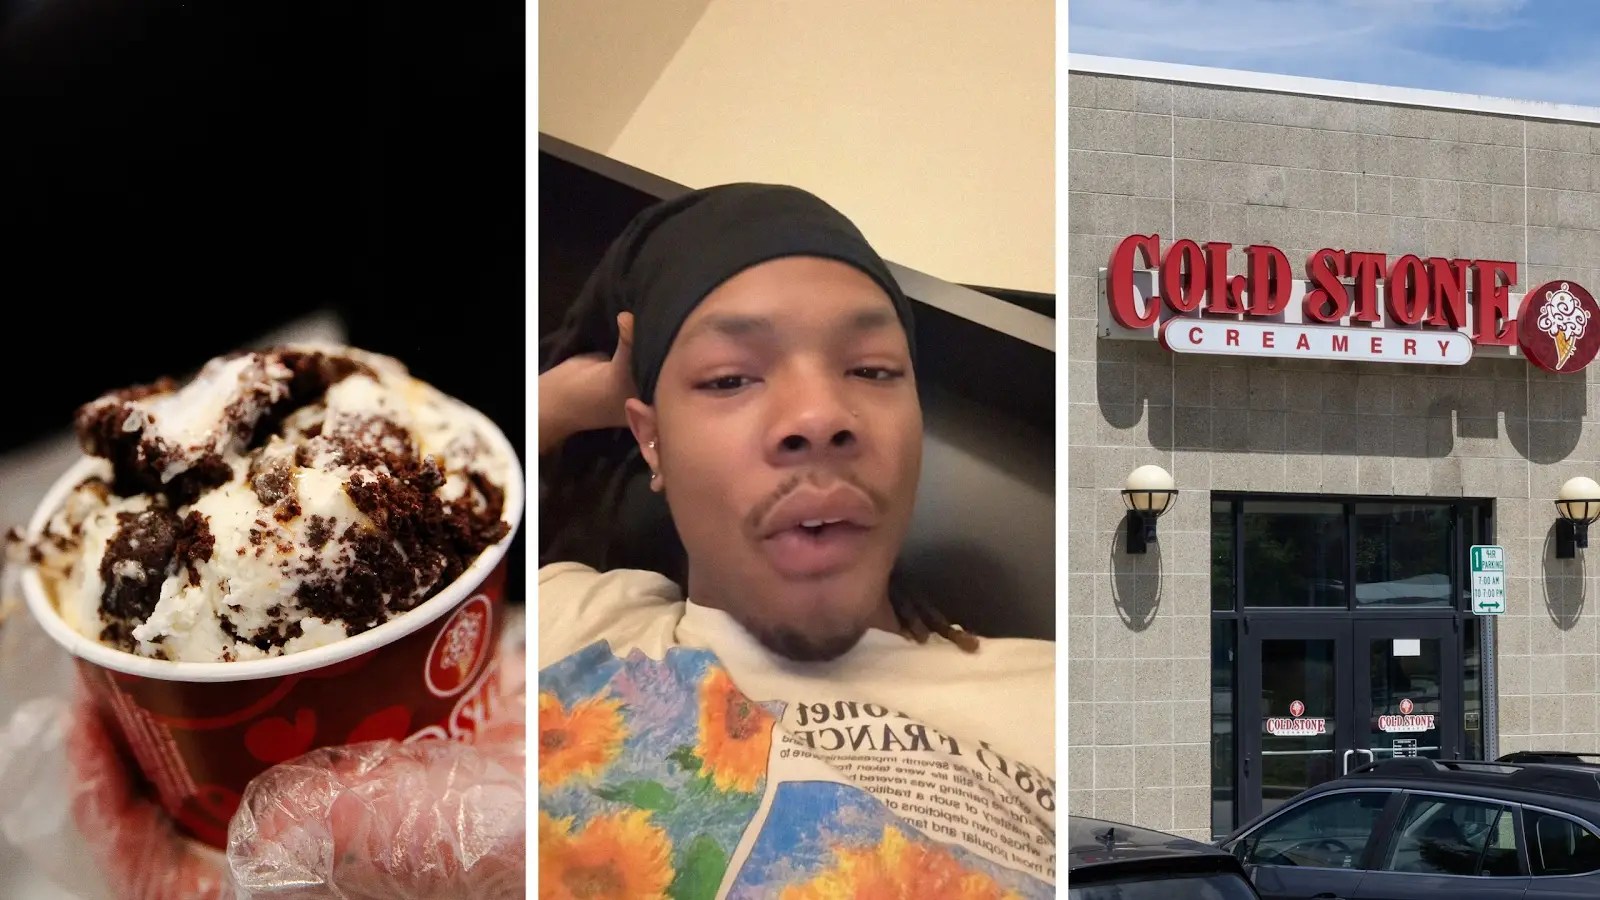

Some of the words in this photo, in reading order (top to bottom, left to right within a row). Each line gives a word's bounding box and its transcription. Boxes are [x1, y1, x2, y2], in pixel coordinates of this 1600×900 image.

[1107, 234, 1293, 329] COLD
[1302, 247, 1517, 346] STONE
[1188, 327, 1451, 358] CREAMERY
[1475, 551, 1479, 568] 1
[1482, 560, 1504, 569] PARKING
[1268, 719, 1292, 733] COLD
[1294, 719, 1325, 733] STONE
[1379, 716, 1403, 730] COLD
[1404, 715, 1434, 728] STONE
